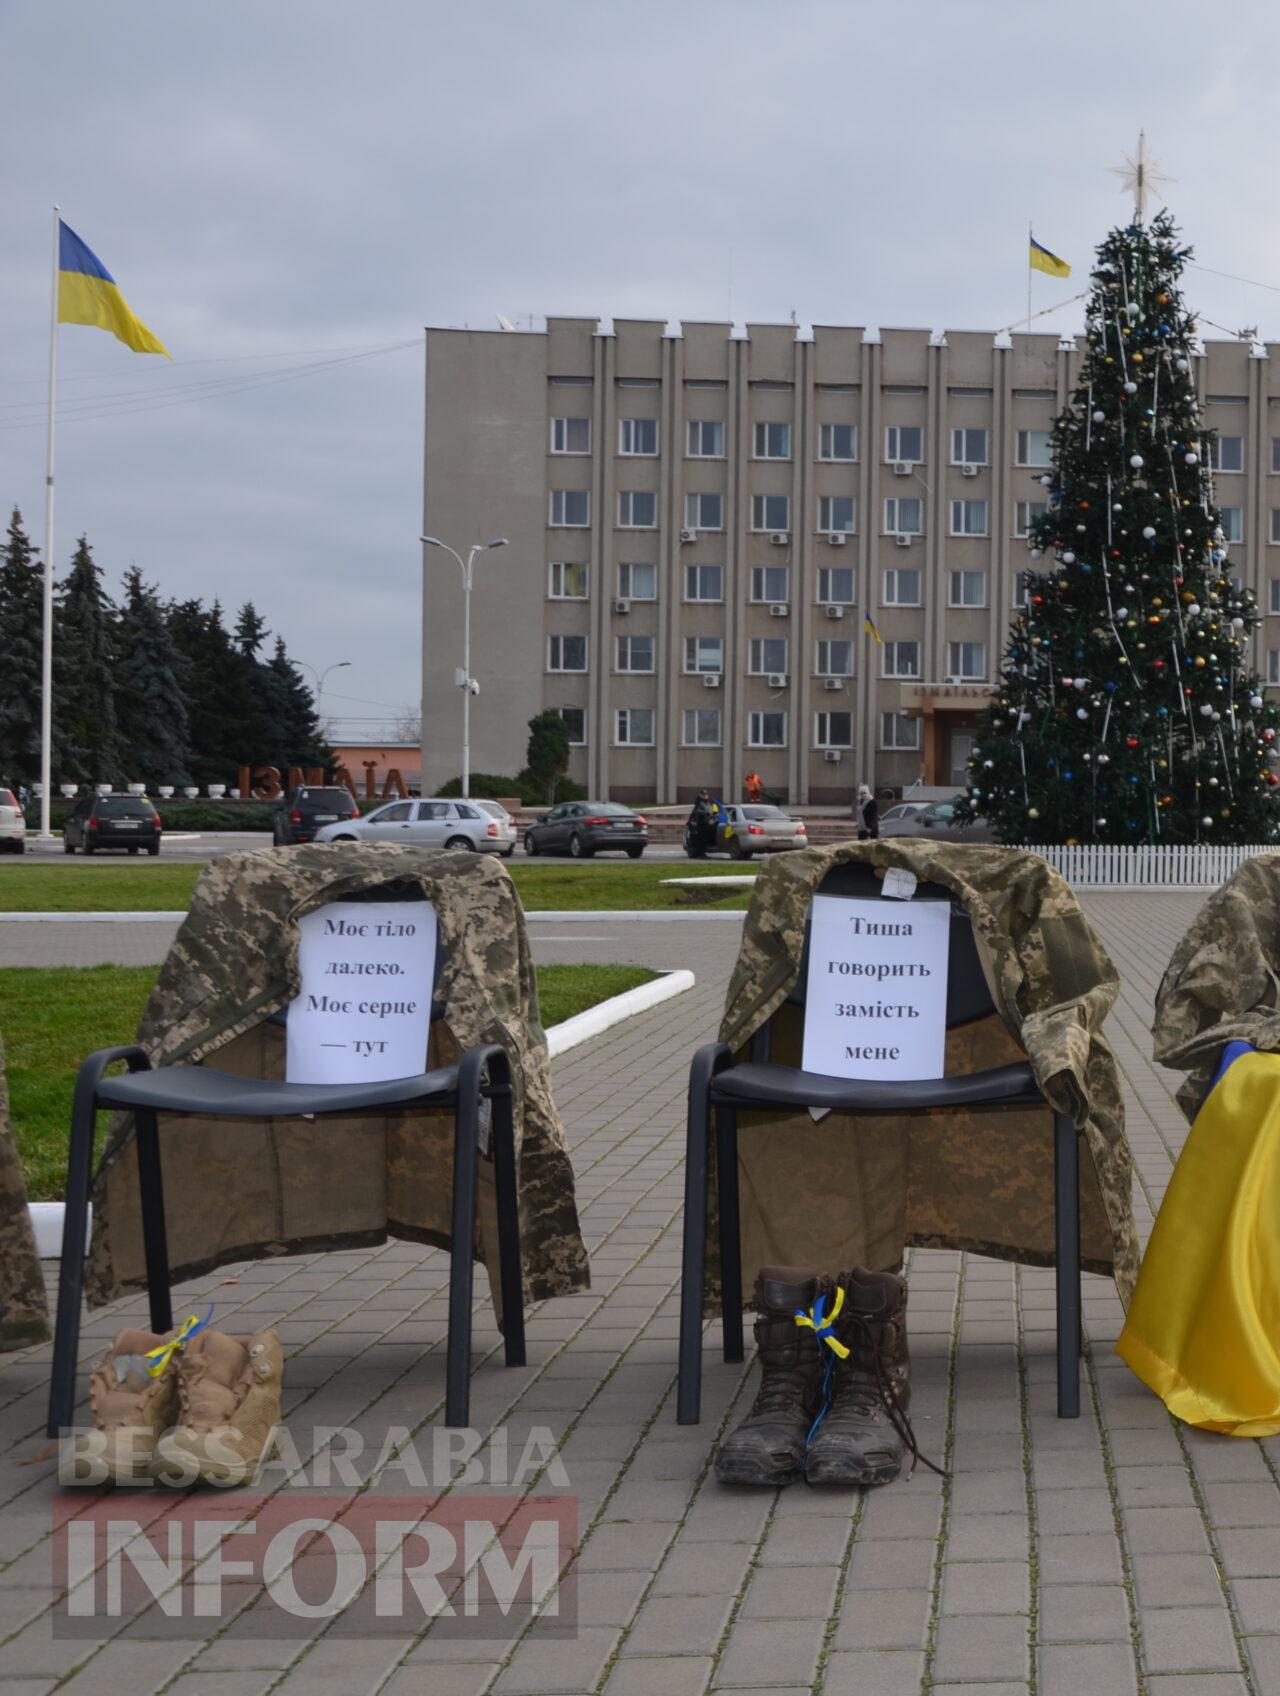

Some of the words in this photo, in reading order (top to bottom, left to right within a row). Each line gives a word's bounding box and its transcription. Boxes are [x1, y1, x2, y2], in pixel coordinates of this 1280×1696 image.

[324, 919, 369, 937] Моє
[374, 920, 416, 937] тіло
[850, 917, 913, 936] Тиша
[324, 961, 405, 975] далеко.
[828, 961, 931, 981] говорить
[306, 995, 352, 1013] Моє
[358, 1000, 417, 1018] серце
[834, 1001, 920, 1018] замість
[353, 1040, 389, 1057] тут
[845, 1046, 900, 1060] мене
